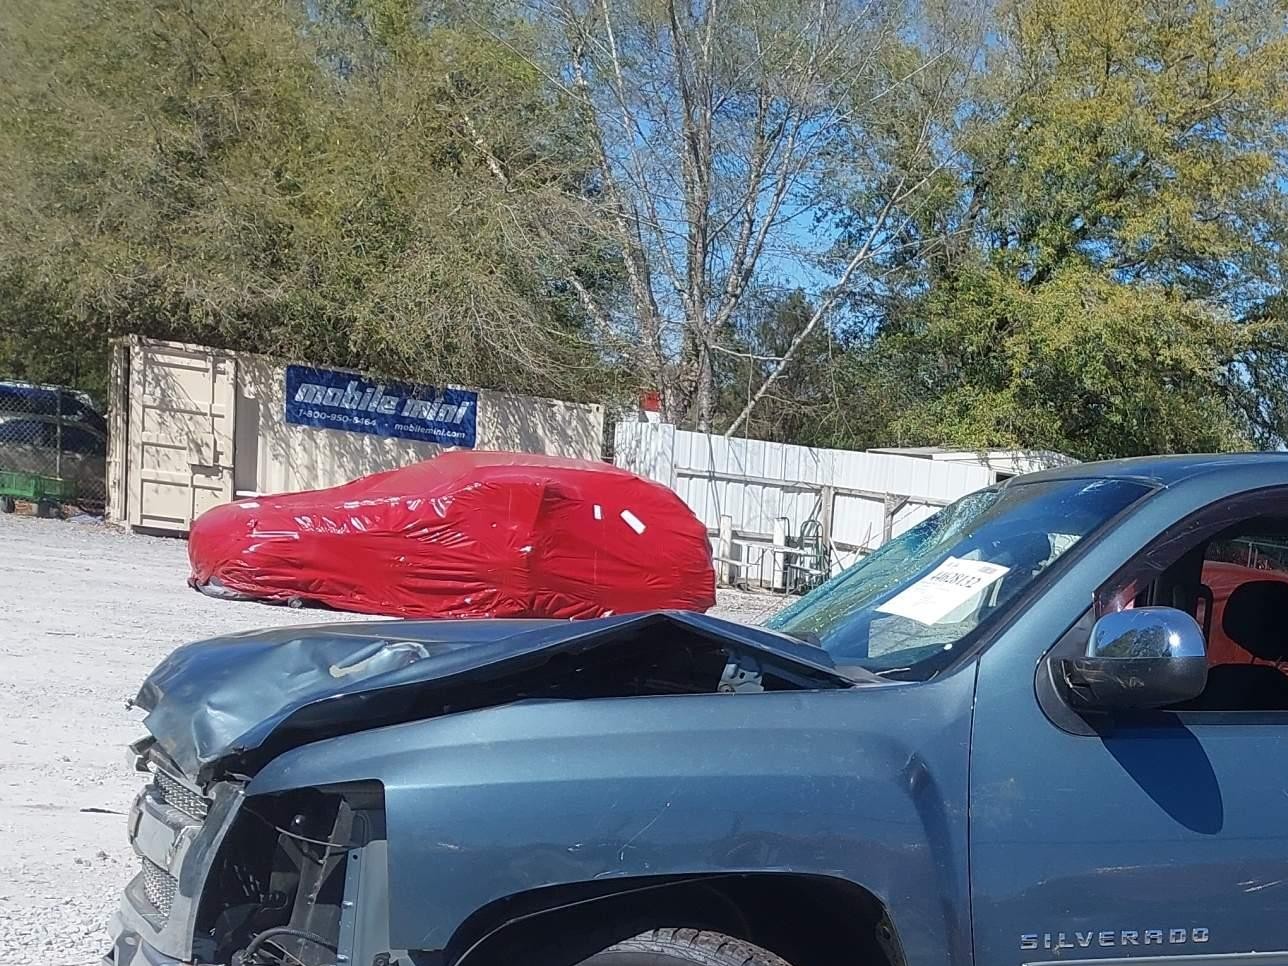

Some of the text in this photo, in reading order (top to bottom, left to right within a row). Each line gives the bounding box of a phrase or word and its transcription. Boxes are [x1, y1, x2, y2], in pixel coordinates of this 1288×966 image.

[295, 381, 470, 424] mobile mini
[394, 423, 466, 439] mobilemini.com
[1020, 927, 1209, 950] SILVERADO
